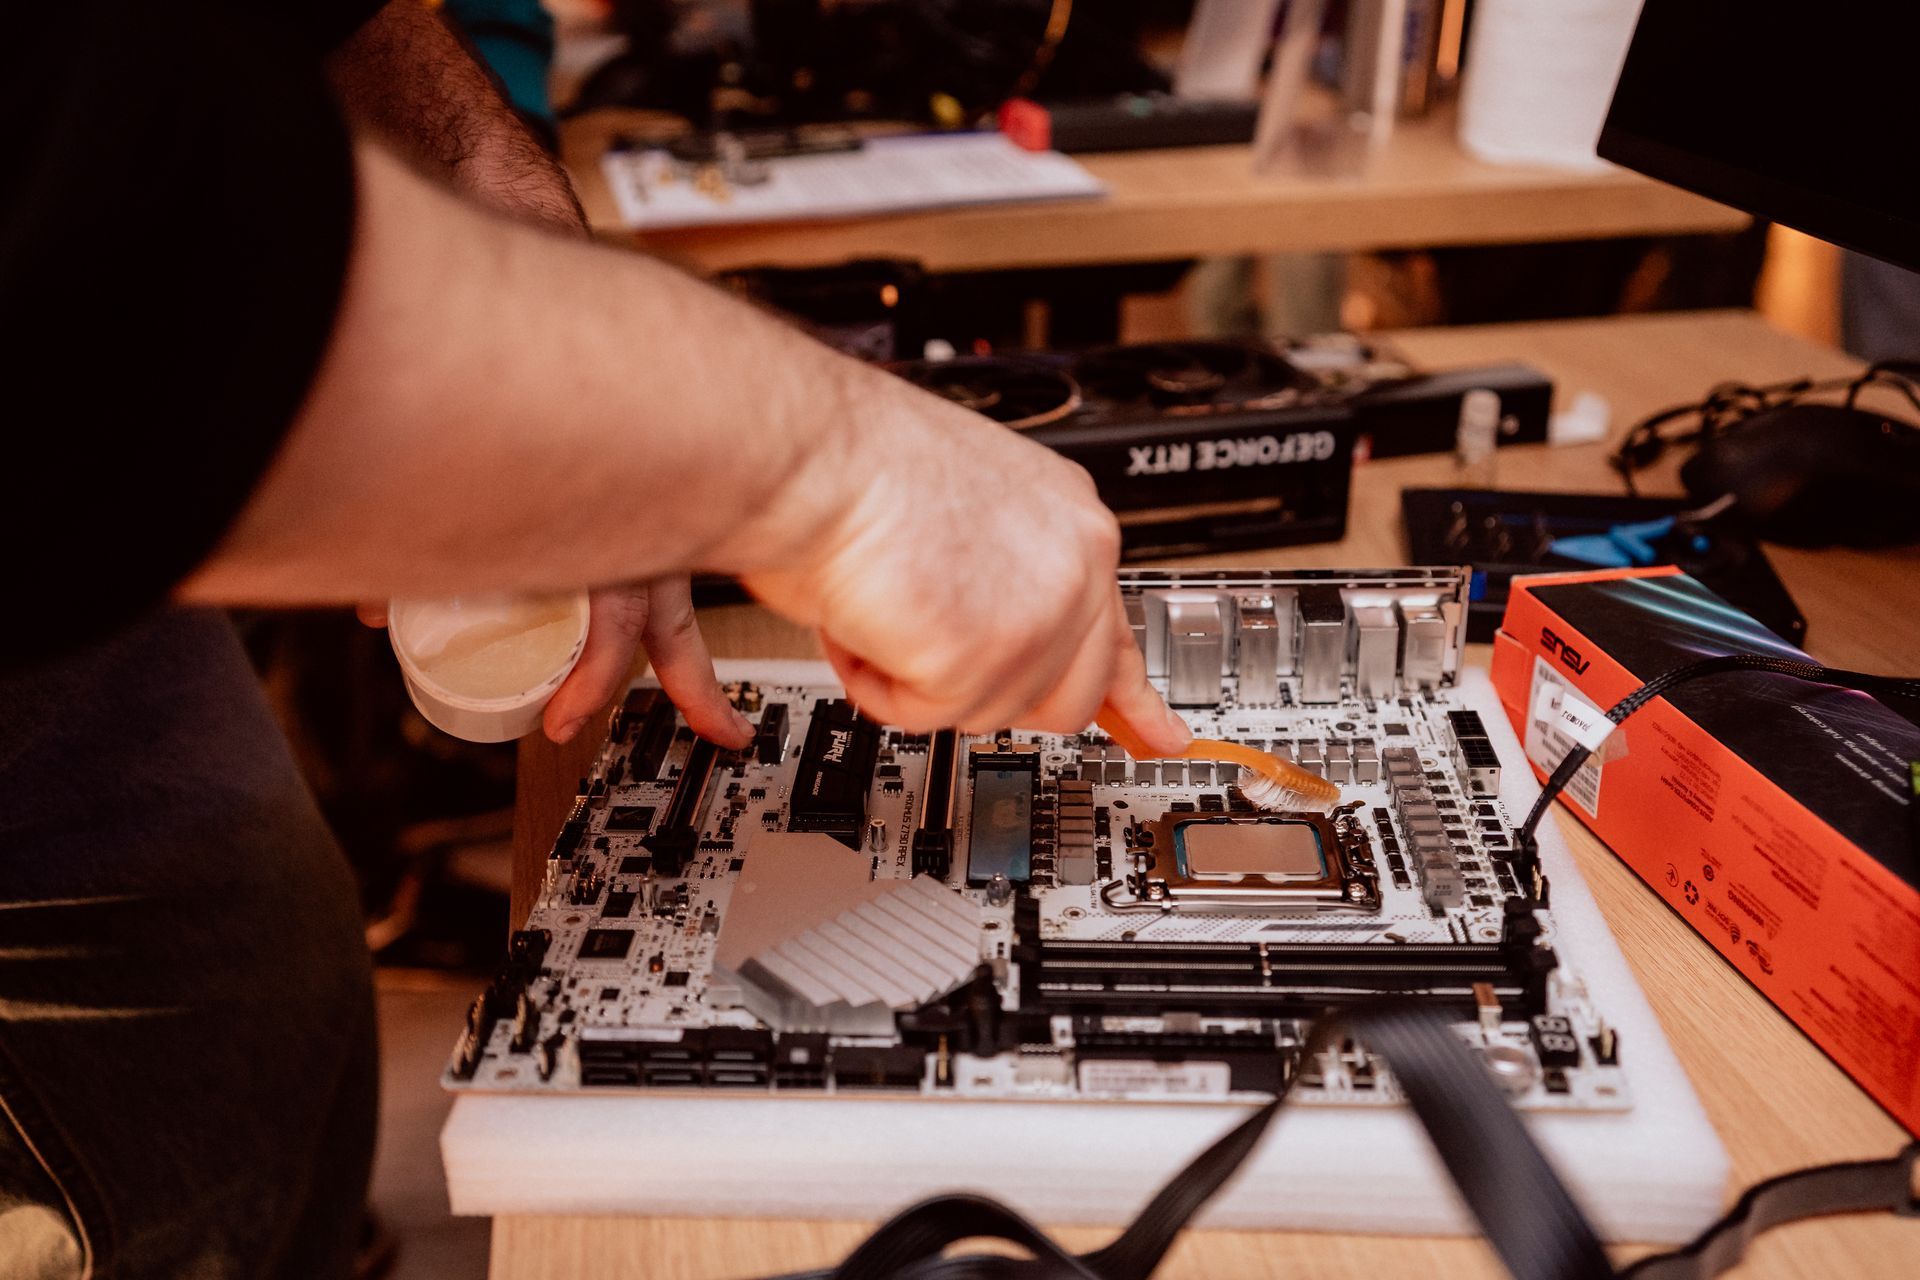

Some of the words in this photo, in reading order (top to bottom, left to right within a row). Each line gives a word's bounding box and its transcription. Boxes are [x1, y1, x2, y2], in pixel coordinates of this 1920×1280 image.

[1125, 442, 1191, 476] RTX
[1195, 430, 1335, 470] GEFORCE
[1541, 627, 1590, 675] ASUS
[824, 730, 847, 763] FURY
[902, 791, 914, 825] MAXIMUS
[900, 824, 911, 845] Z790
[896, 845, 908, 867] APEX
